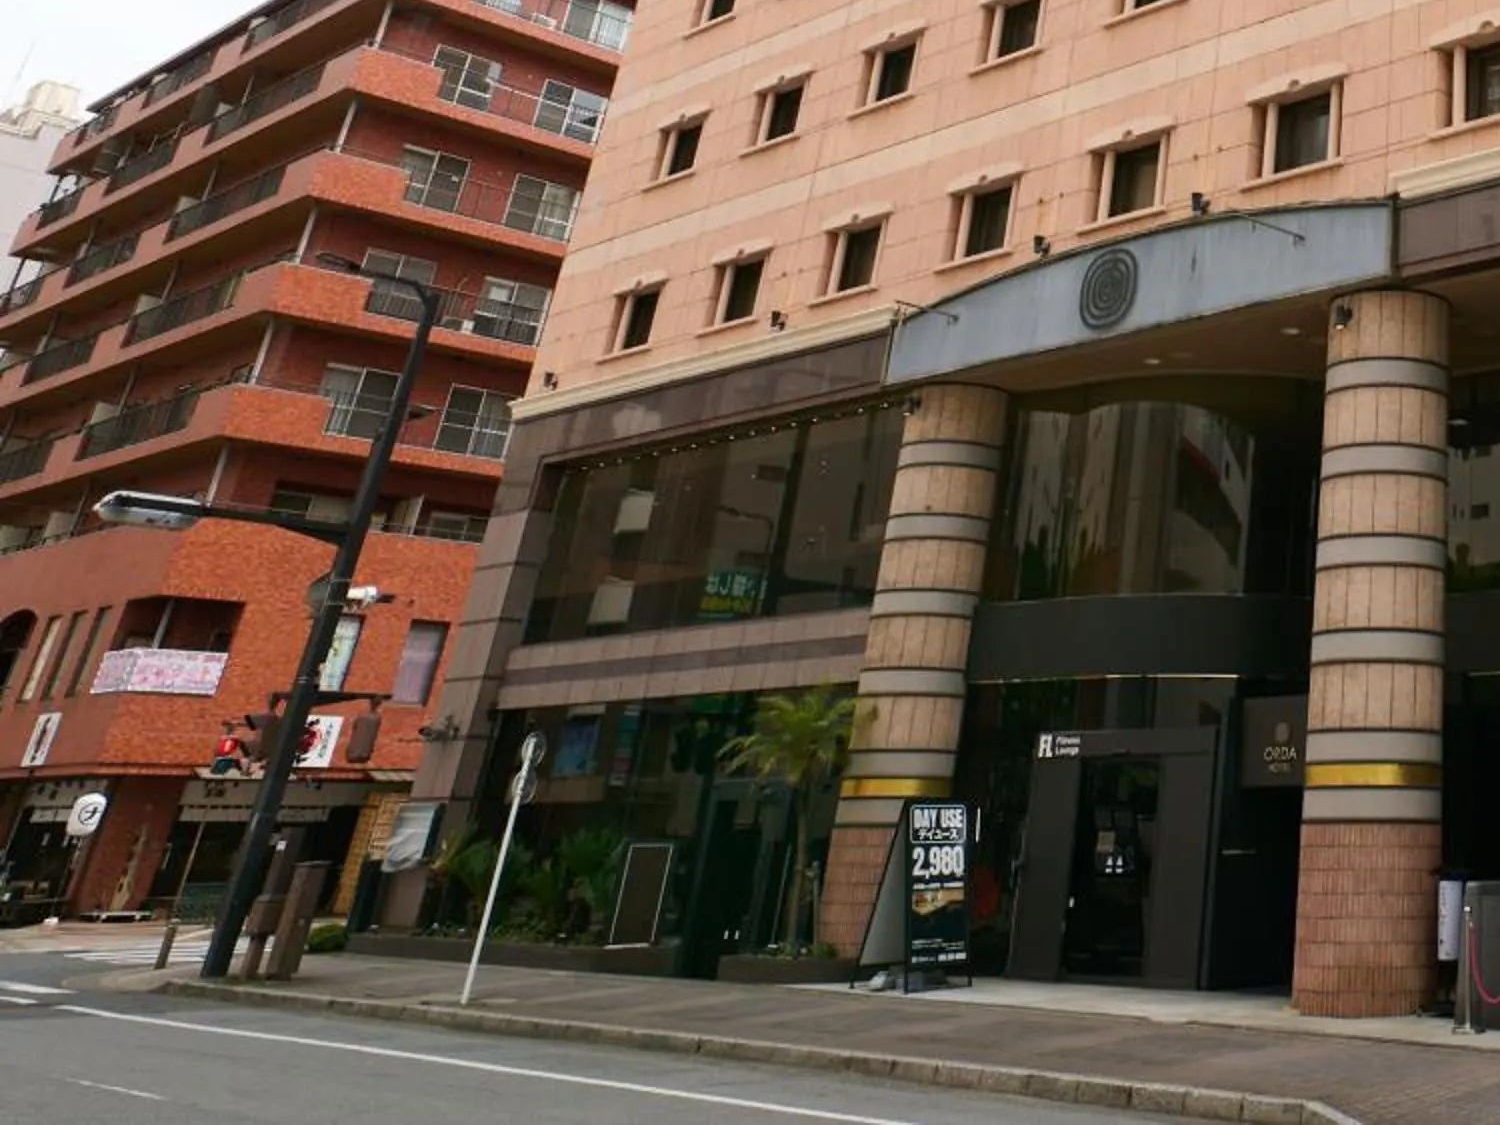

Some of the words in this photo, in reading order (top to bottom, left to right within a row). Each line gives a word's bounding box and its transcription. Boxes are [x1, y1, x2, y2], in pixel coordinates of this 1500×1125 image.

[913, 808, 938, 828] DAY
[939, 808, 963, 828] USE
[917, 829, 959, 840] デイユース
